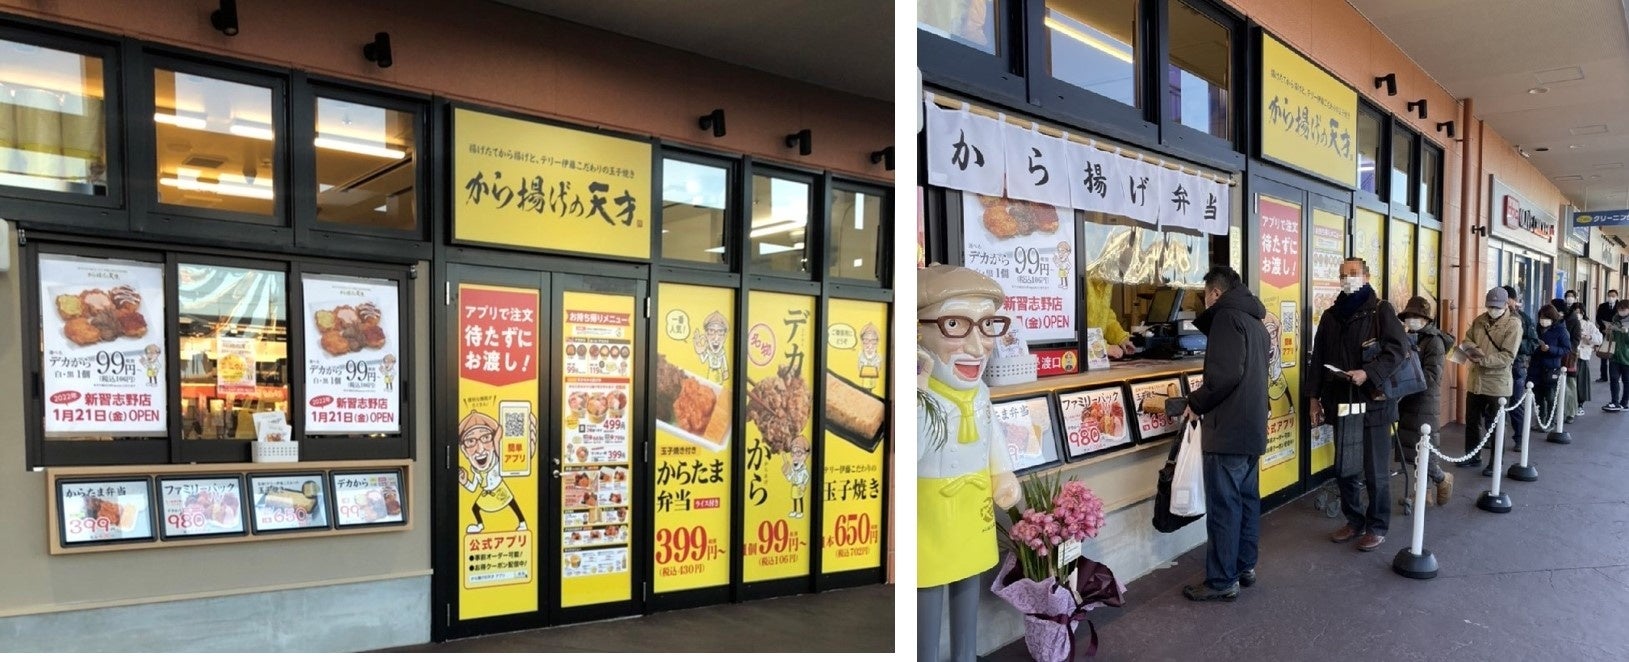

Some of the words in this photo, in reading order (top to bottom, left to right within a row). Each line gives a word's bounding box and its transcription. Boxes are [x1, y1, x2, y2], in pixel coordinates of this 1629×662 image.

[1268, 95, 1351, 159] から揚げの天才
[465, 171, 637, 226] から揚げの天才
[1262, 216, 1298, 233] アプリで注文
[1262, 233, 1298, 255] 待たずに
[969, 251, 1010, 266] デカから
[1262, 256, 1297, 276] お渡し!
[1003, 297, 1063, 311] 新習志野店
[465, 305, 534, 323] アプリで注文
[569, 312, 628, 324] お持ち帰りメニュー
[465, 325, 532, 348] 待たずに
[49, 356, 91, 368] デカから
[464, 350, 531, 373] お渡し!
[84, 392, 151, 407] 新習志野店
[336, 397, 388, 410] 新習志野店
[1063, 392, 1119, 411] ファミリーパック
[504, 454, 526, 463] アプリ
[657, 458, 724, 486] からたま
[164, 483, 235, 495] ファミリーパック
[337, 478, 369, 488] デカから
[824, 478, 880, 501] 玉子焼き
[66, 486, 126, 498] からたま弁当
[657, 489, 691, 512] 弁当
[695, 498, 719, 508] ライス付き
[469, 535, 527, 551] 公式アプリ
